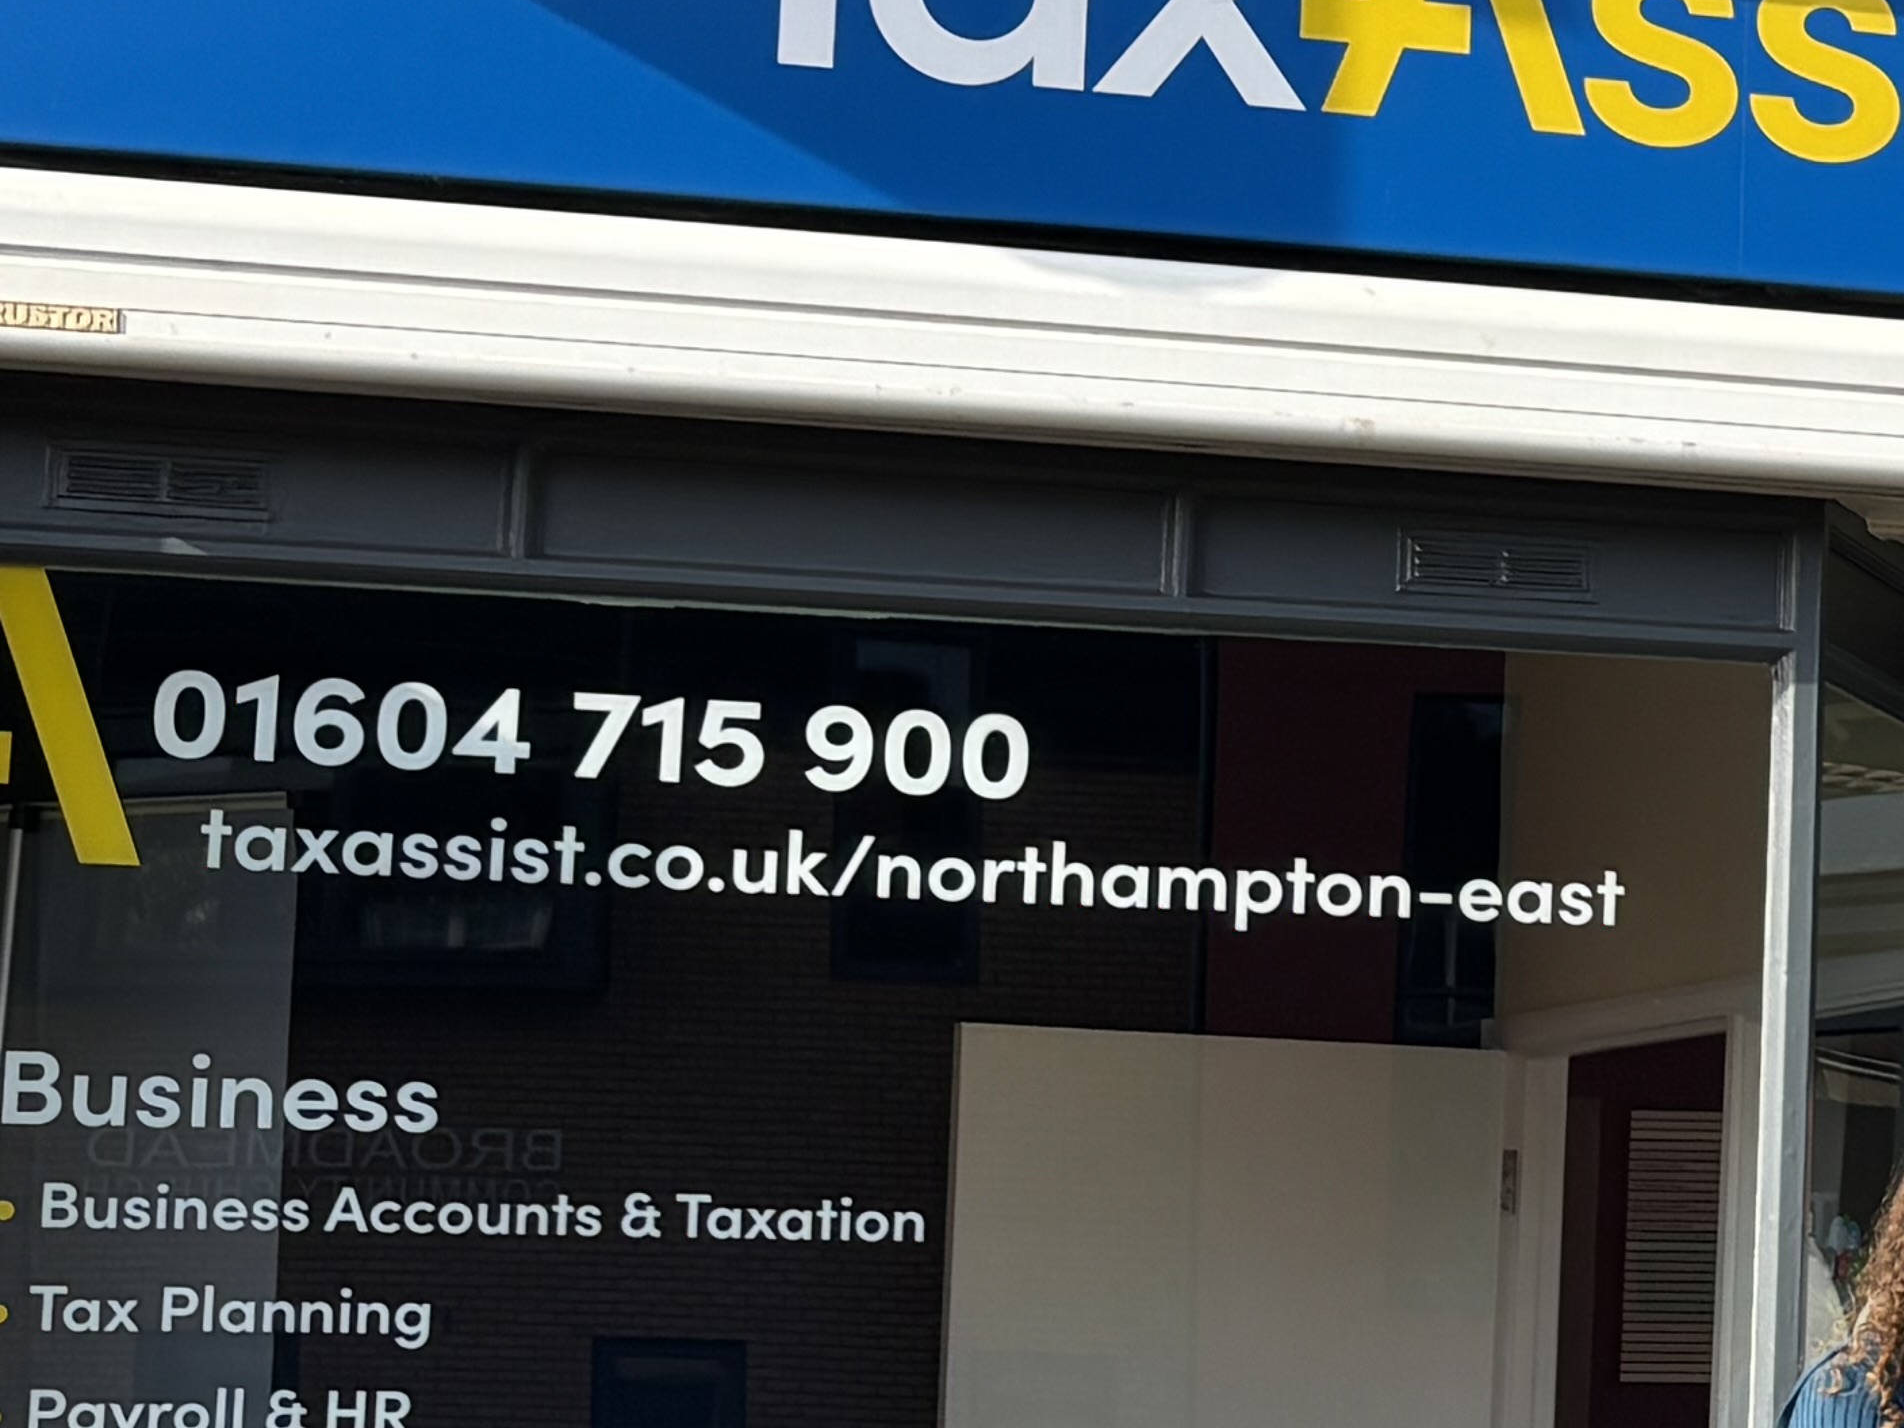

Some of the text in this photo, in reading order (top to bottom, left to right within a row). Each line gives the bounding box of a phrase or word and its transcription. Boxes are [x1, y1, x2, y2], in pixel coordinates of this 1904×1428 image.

[152, 669, 1030, 799] 01604 715 900
[201, 808, 1625, 931] taxassist.co.uk/northampton-east
[1, 1049, 440, 1134] Business
[40, 1181, 926, 1243] Business Accounts & Taxation
[29, 1283, 432, 1350] Tax Planning
